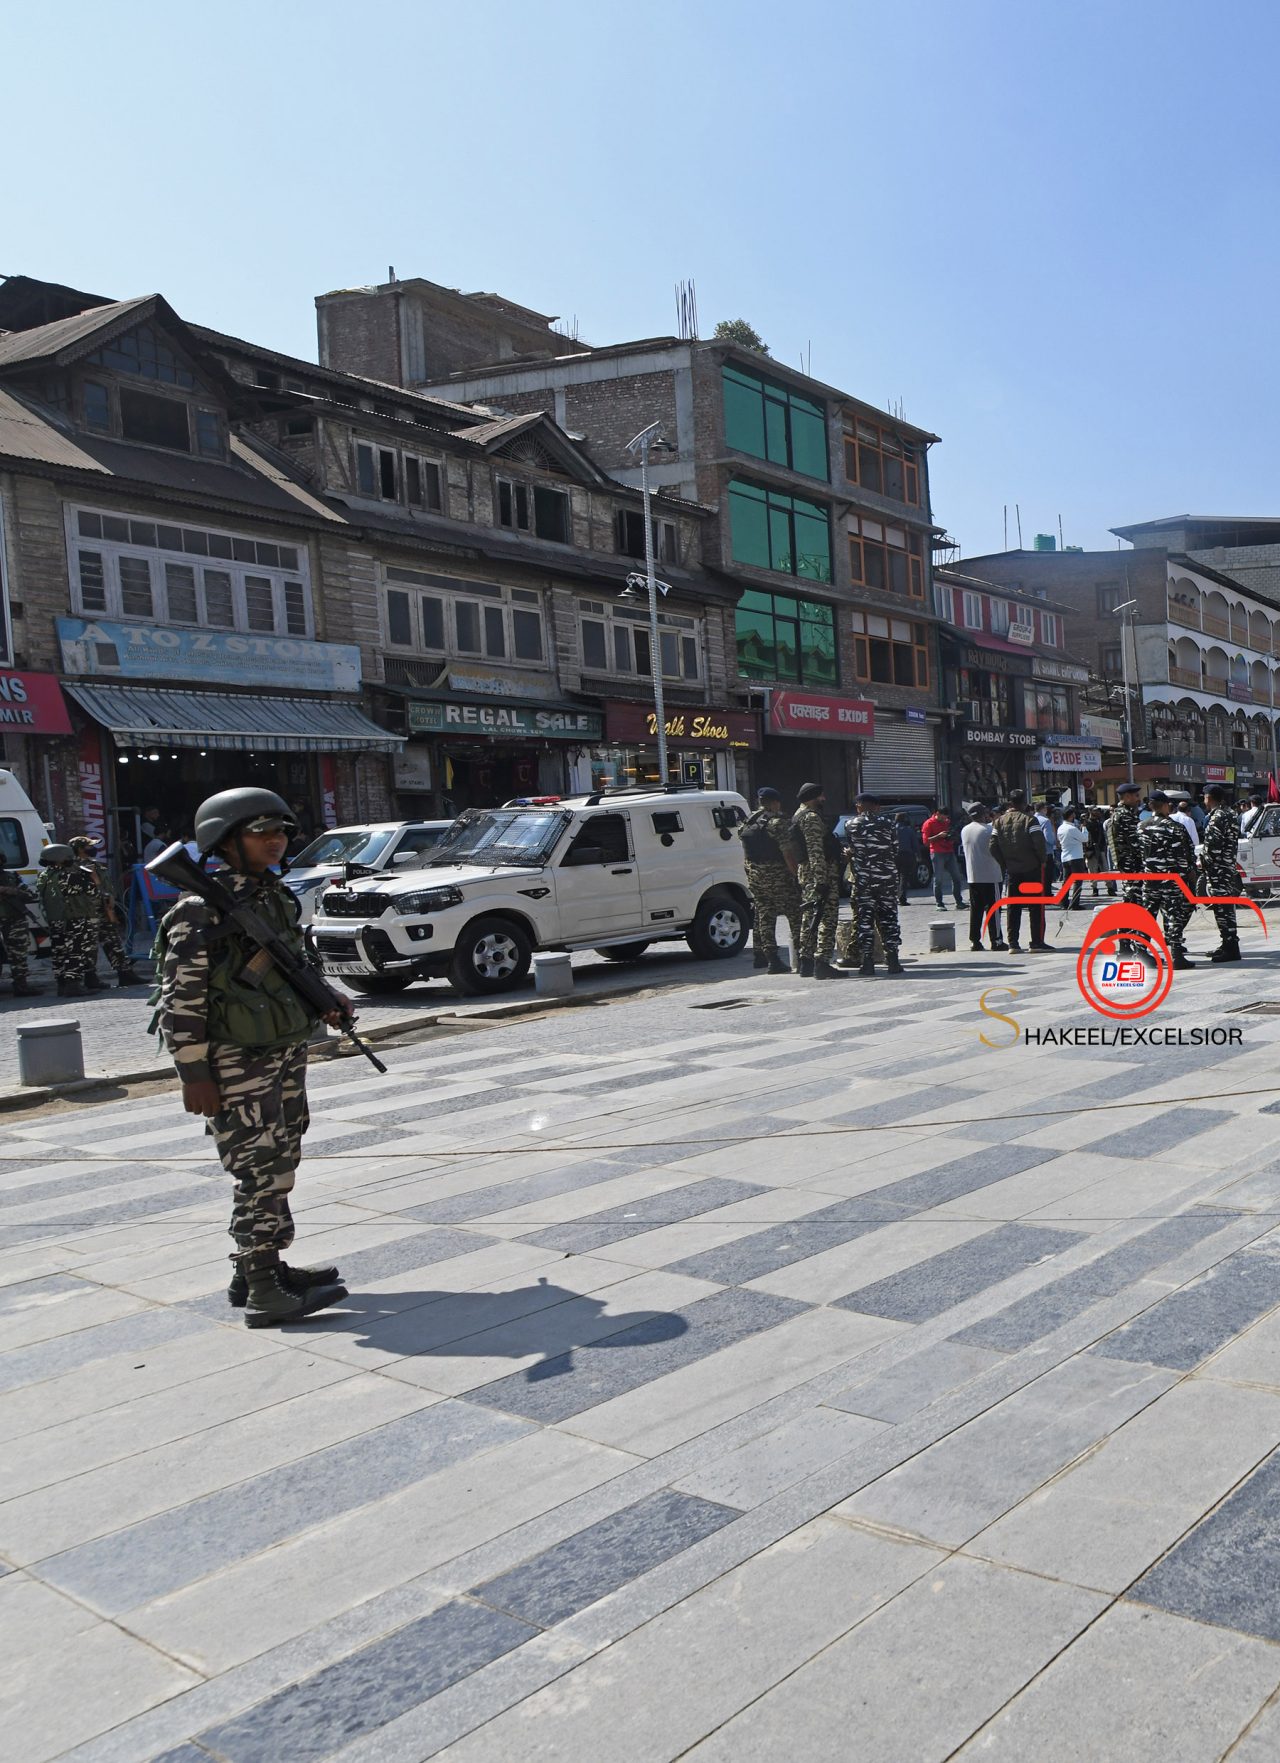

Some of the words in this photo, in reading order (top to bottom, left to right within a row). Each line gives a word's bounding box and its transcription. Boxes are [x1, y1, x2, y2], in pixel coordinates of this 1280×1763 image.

[79, 623, 113, 642] A
[122, 626, 181, 648] TO
[189, 633, 217, 650] Z
[226, 636, 348, 660] STORE
[446, 705, 525, 727] REGAL
[535, 712, 588, 731] SALE
[838, 708, 868, 724] EXIDE
[690, 716, 728, 739] Shoes
[967, 730, 1004, 743] BOMBAY
[1009, 733, 1037, 745] STORE
[1053, 751, 1082, 765] EXIDE
[689, 765, 697, 777] P
